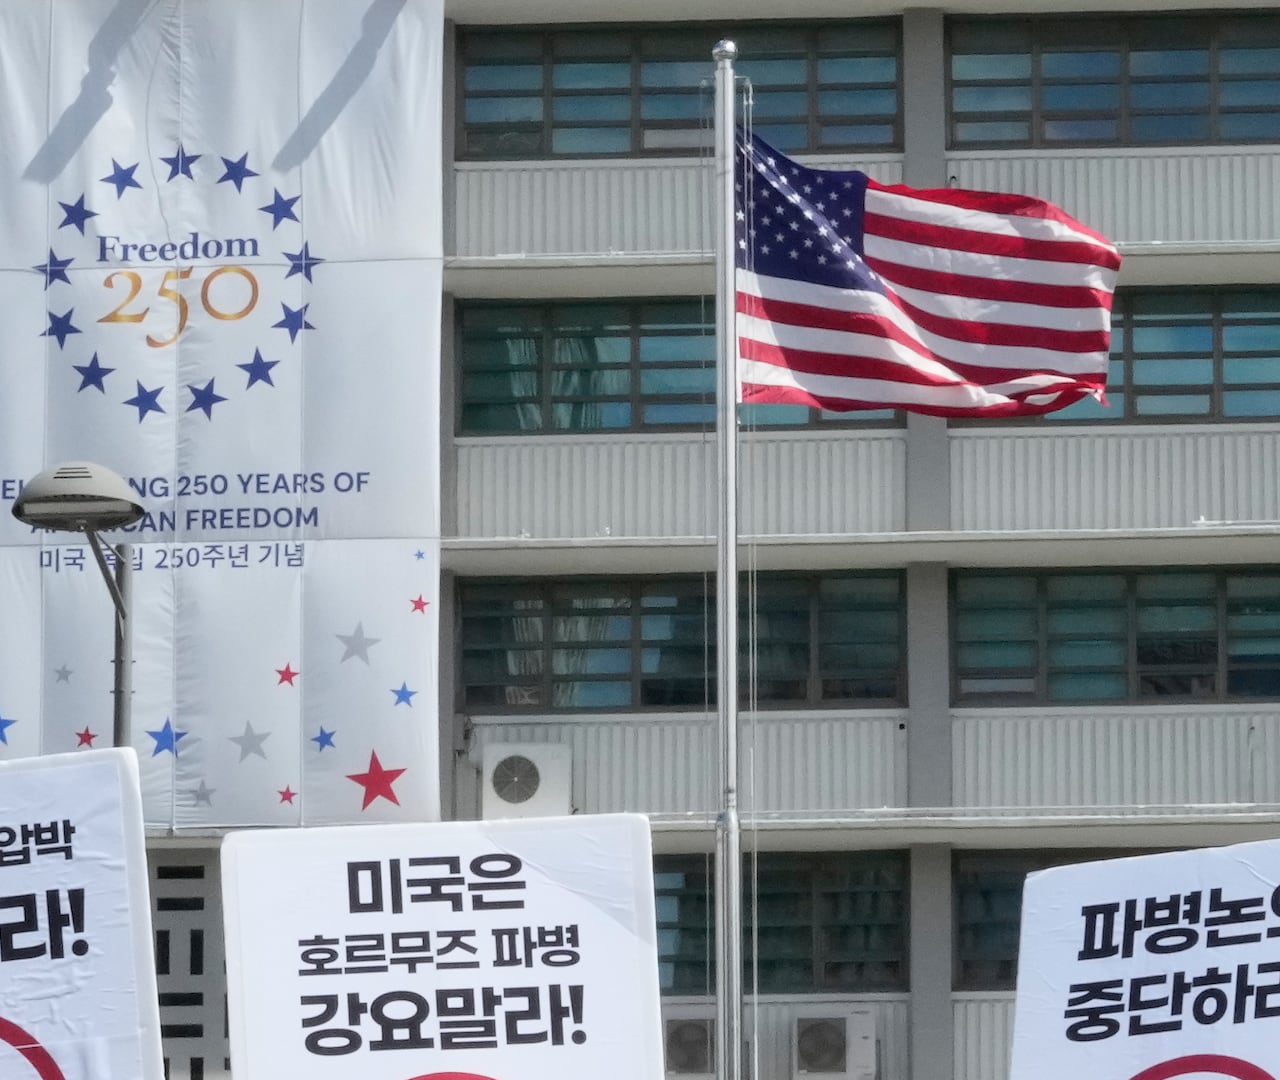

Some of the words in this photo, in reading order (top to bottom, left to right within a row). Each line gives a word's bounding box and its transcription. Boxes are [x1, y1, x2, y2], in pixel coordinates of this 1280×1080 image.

[97, 232, 260, 262] Freedom
[96, 265, 259, 348] 250
[177, 475, 228, 496] 250
[237, 472, 325, 495] YEARS
[334, 472, 370, 494] OF
[186, 506, 319, 530] FREEDOM
[39, 547, 86, 573] 미국
[154, 544, 250, 570] 250주년
[258, 543, 305, 568] 기념
[346, 853, 526, 914] 미국은
[298, 930, 480, 976] 호르무즈
[491, 924, 580, 968] 파병
[300, 984, 587, 1056] 강요말라!
